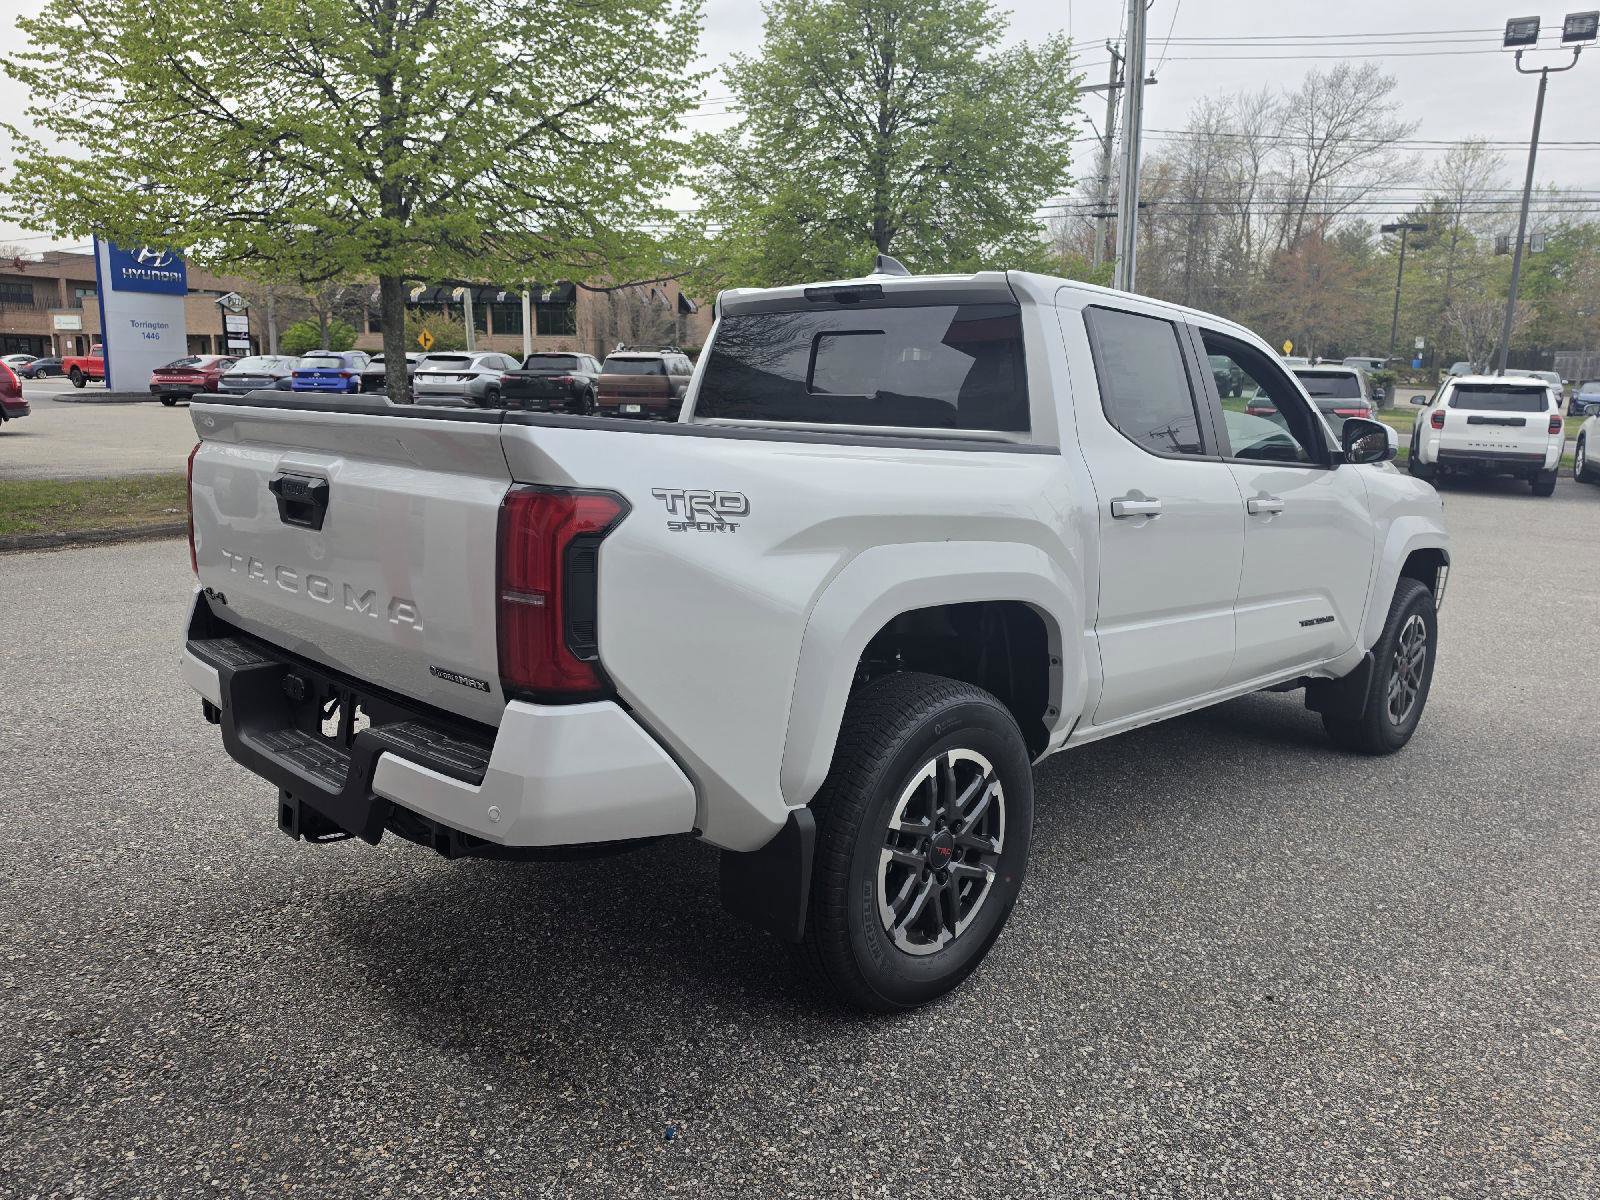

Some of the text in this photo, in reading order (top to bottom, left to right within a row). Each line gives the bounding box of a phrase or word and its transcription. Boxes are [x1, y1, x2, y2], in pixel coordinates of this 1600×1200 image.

[122, 267, 182, 282] HYUNDAI
[129, 319, 169, 331] Torrington
[141, 332, 160, 341] 1446
[651, 487, 750, 523] TRD
[666, 520, 741, 533] SPORT
[221, 548, 424, 631] TACOMA
